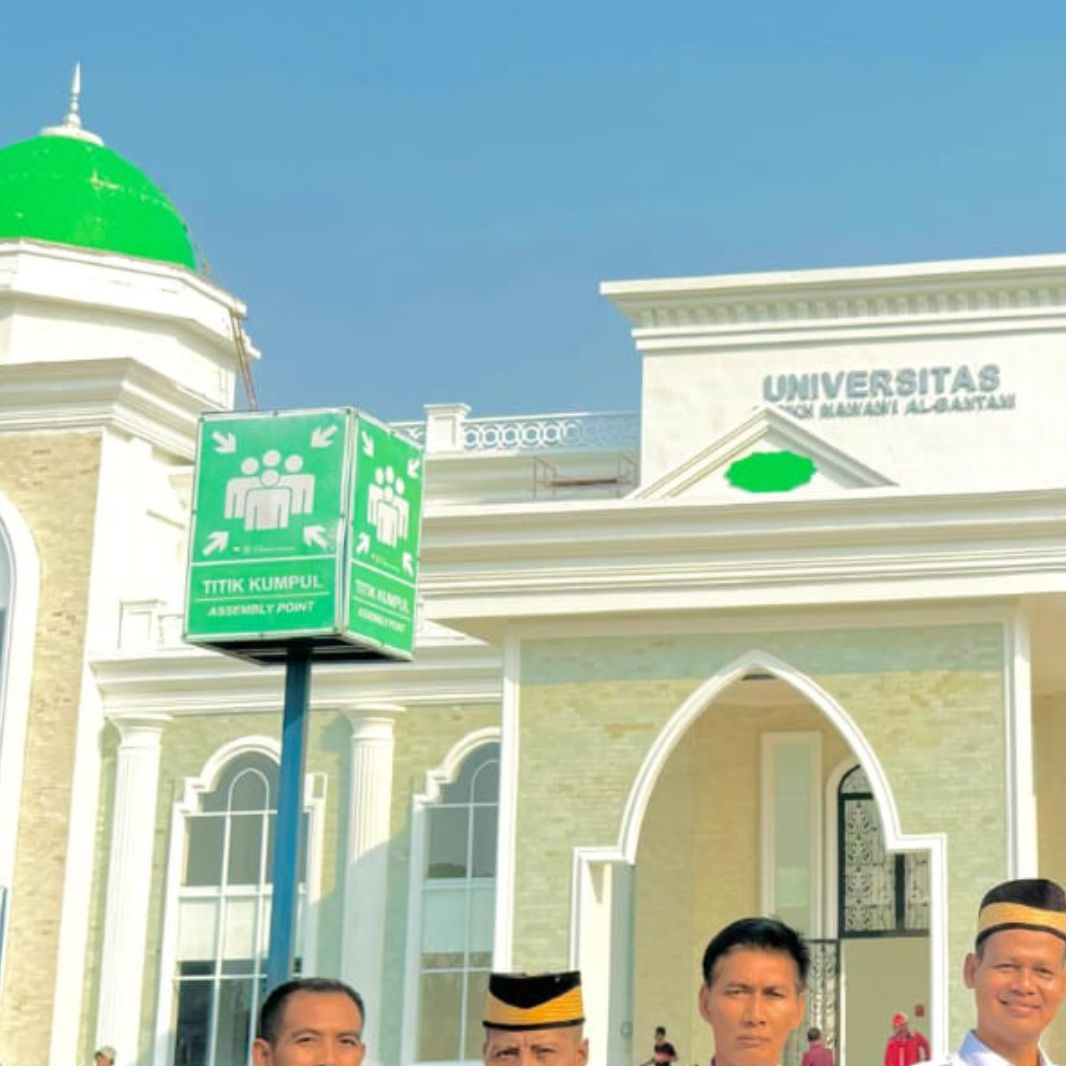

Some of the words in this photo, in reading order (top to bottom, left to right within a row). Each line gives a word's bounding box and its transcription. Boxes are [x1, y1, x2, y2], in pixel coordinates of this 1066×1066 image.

[762, 364, 1001, 402] UNIVERSITAS
[203, 578, 245, 595] TITIK
[249, 575, 324, 592] KUMPUL
[207, 603, 274, 618] ASSEMBLY
[276, 600, 316, 614] POINT
